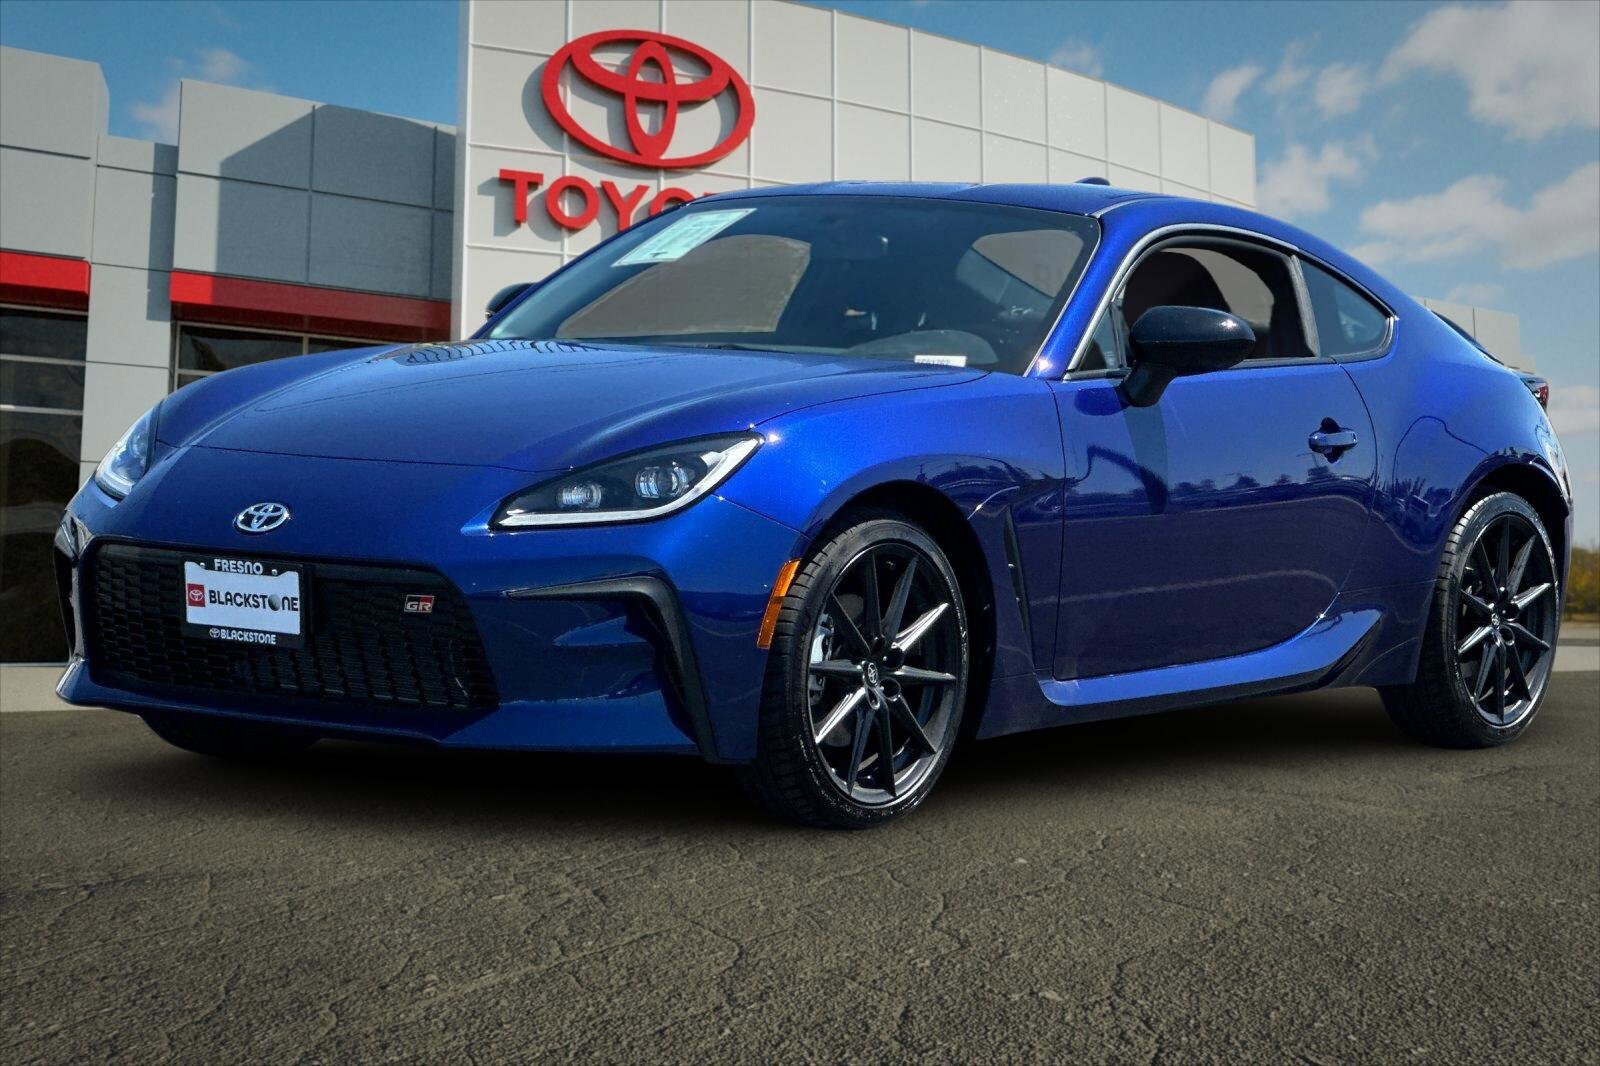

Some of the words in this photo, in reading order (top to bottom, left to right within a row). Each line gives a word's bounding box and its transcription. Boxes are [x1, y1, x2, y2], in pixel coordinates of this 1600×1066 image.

[498, 168, 716, 231] TOY
[214, 559, 263, 575] FRESNO
[209, 590, 299, 612] BLACKSTONE
[405, 601, 433, 612] GR
[220, 629, 277, 645] BLACKSTONE
